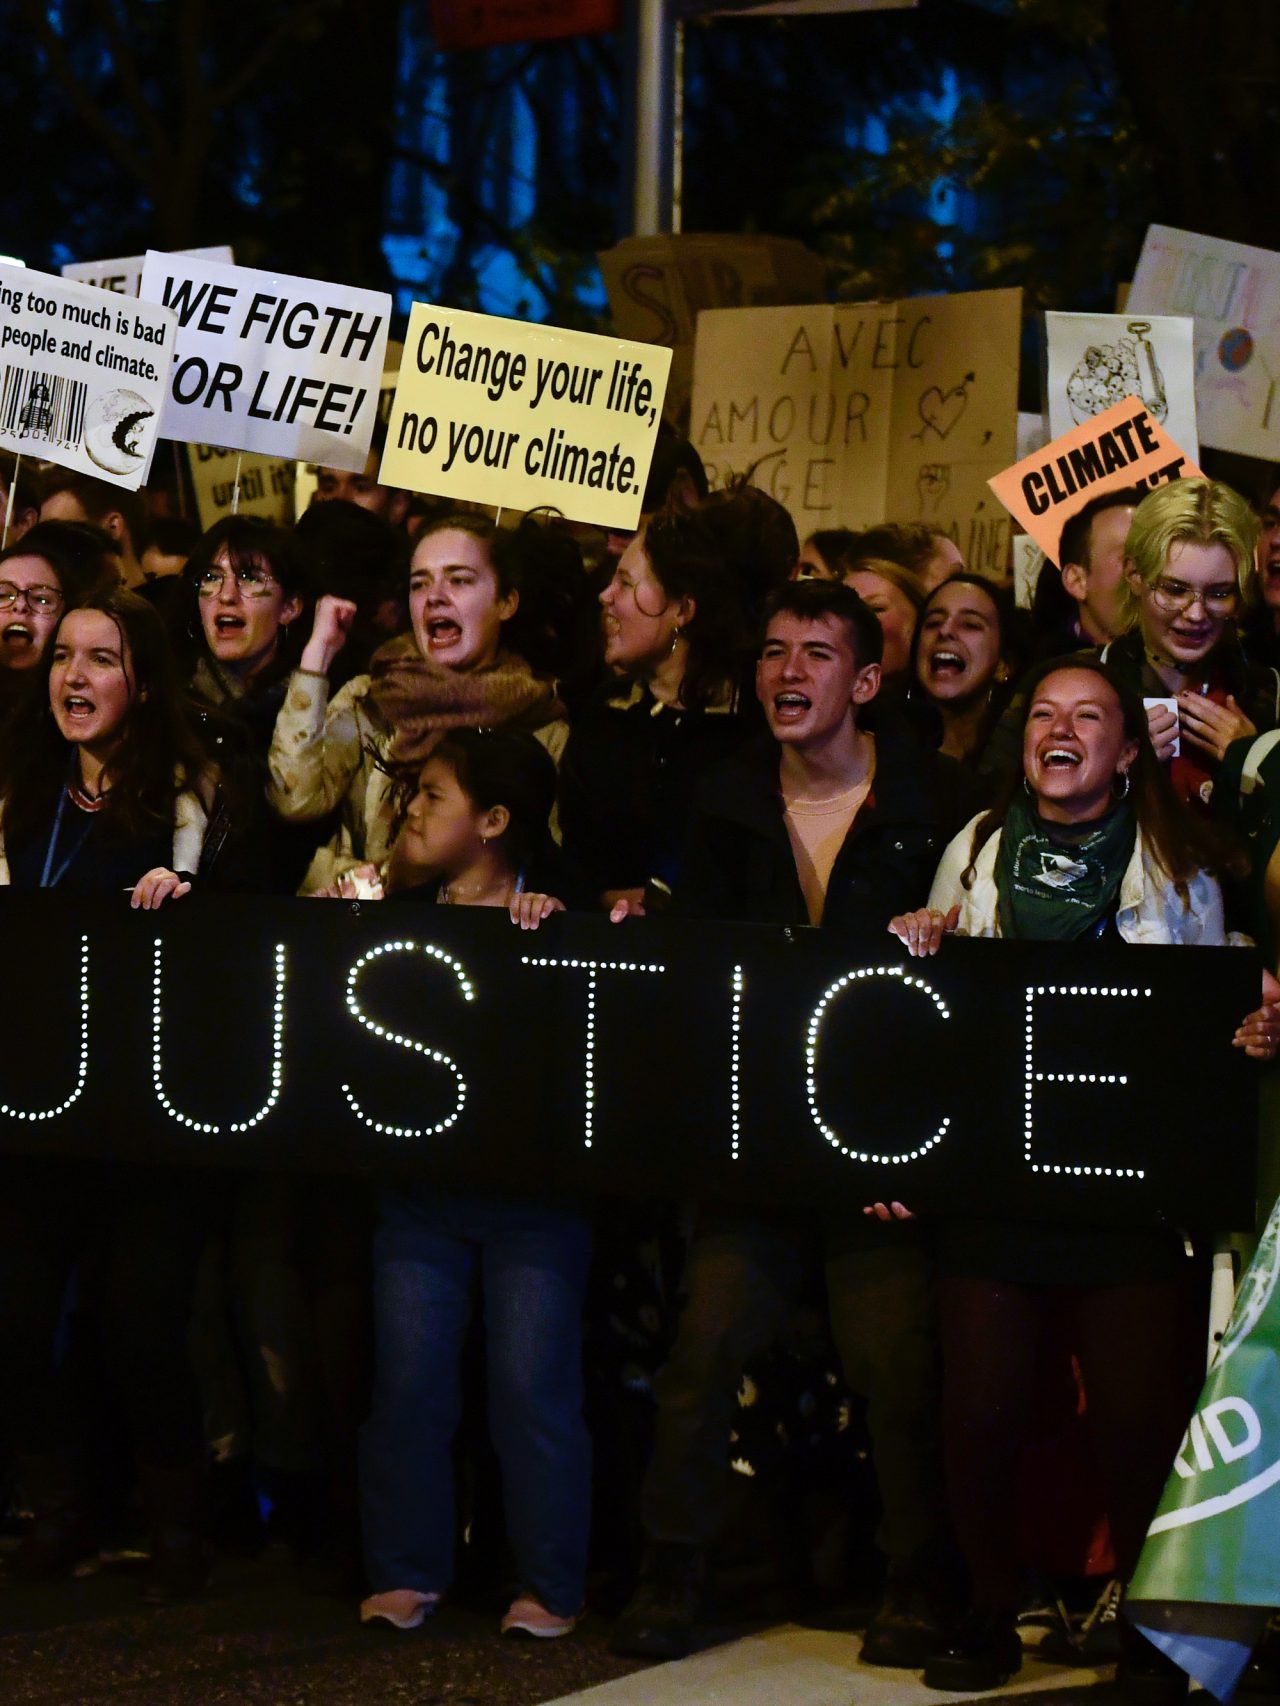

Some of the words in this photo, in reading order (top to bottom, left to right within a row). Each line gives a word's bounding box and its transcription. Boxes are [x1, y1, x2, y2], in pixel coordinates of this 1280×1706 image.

[1, 324, 57, 356] people
[60, 340, 92, 362] and
[95, 345, 159, 382] climate.
[27, 291, 57, 316] too
[62, 302, 111, 331] much
[116, 311, 129, 336] is
[133, 316, 166, 346] bad
[161, 276, 238, 335] WE
[239, 293, 383, 362] FIGTH
[780, 316, 932, 375] AVEC
[172, 354, 243, 413] OR
[247, 371, 367, 435] LIFE!
[416, 322, 527, 402] Change
[529, 358, 603, 409] your
[606, 359, 657, 428] life,
[397, 412, 438, 454] no
[441, 421, 520, 472] your
[524, 428, 640, 495] climate.
[699, 391, 871, 447] AMOUR
[212, 468, 265, 508] until
[1021, 412, 1160, 516] CLIMATE
